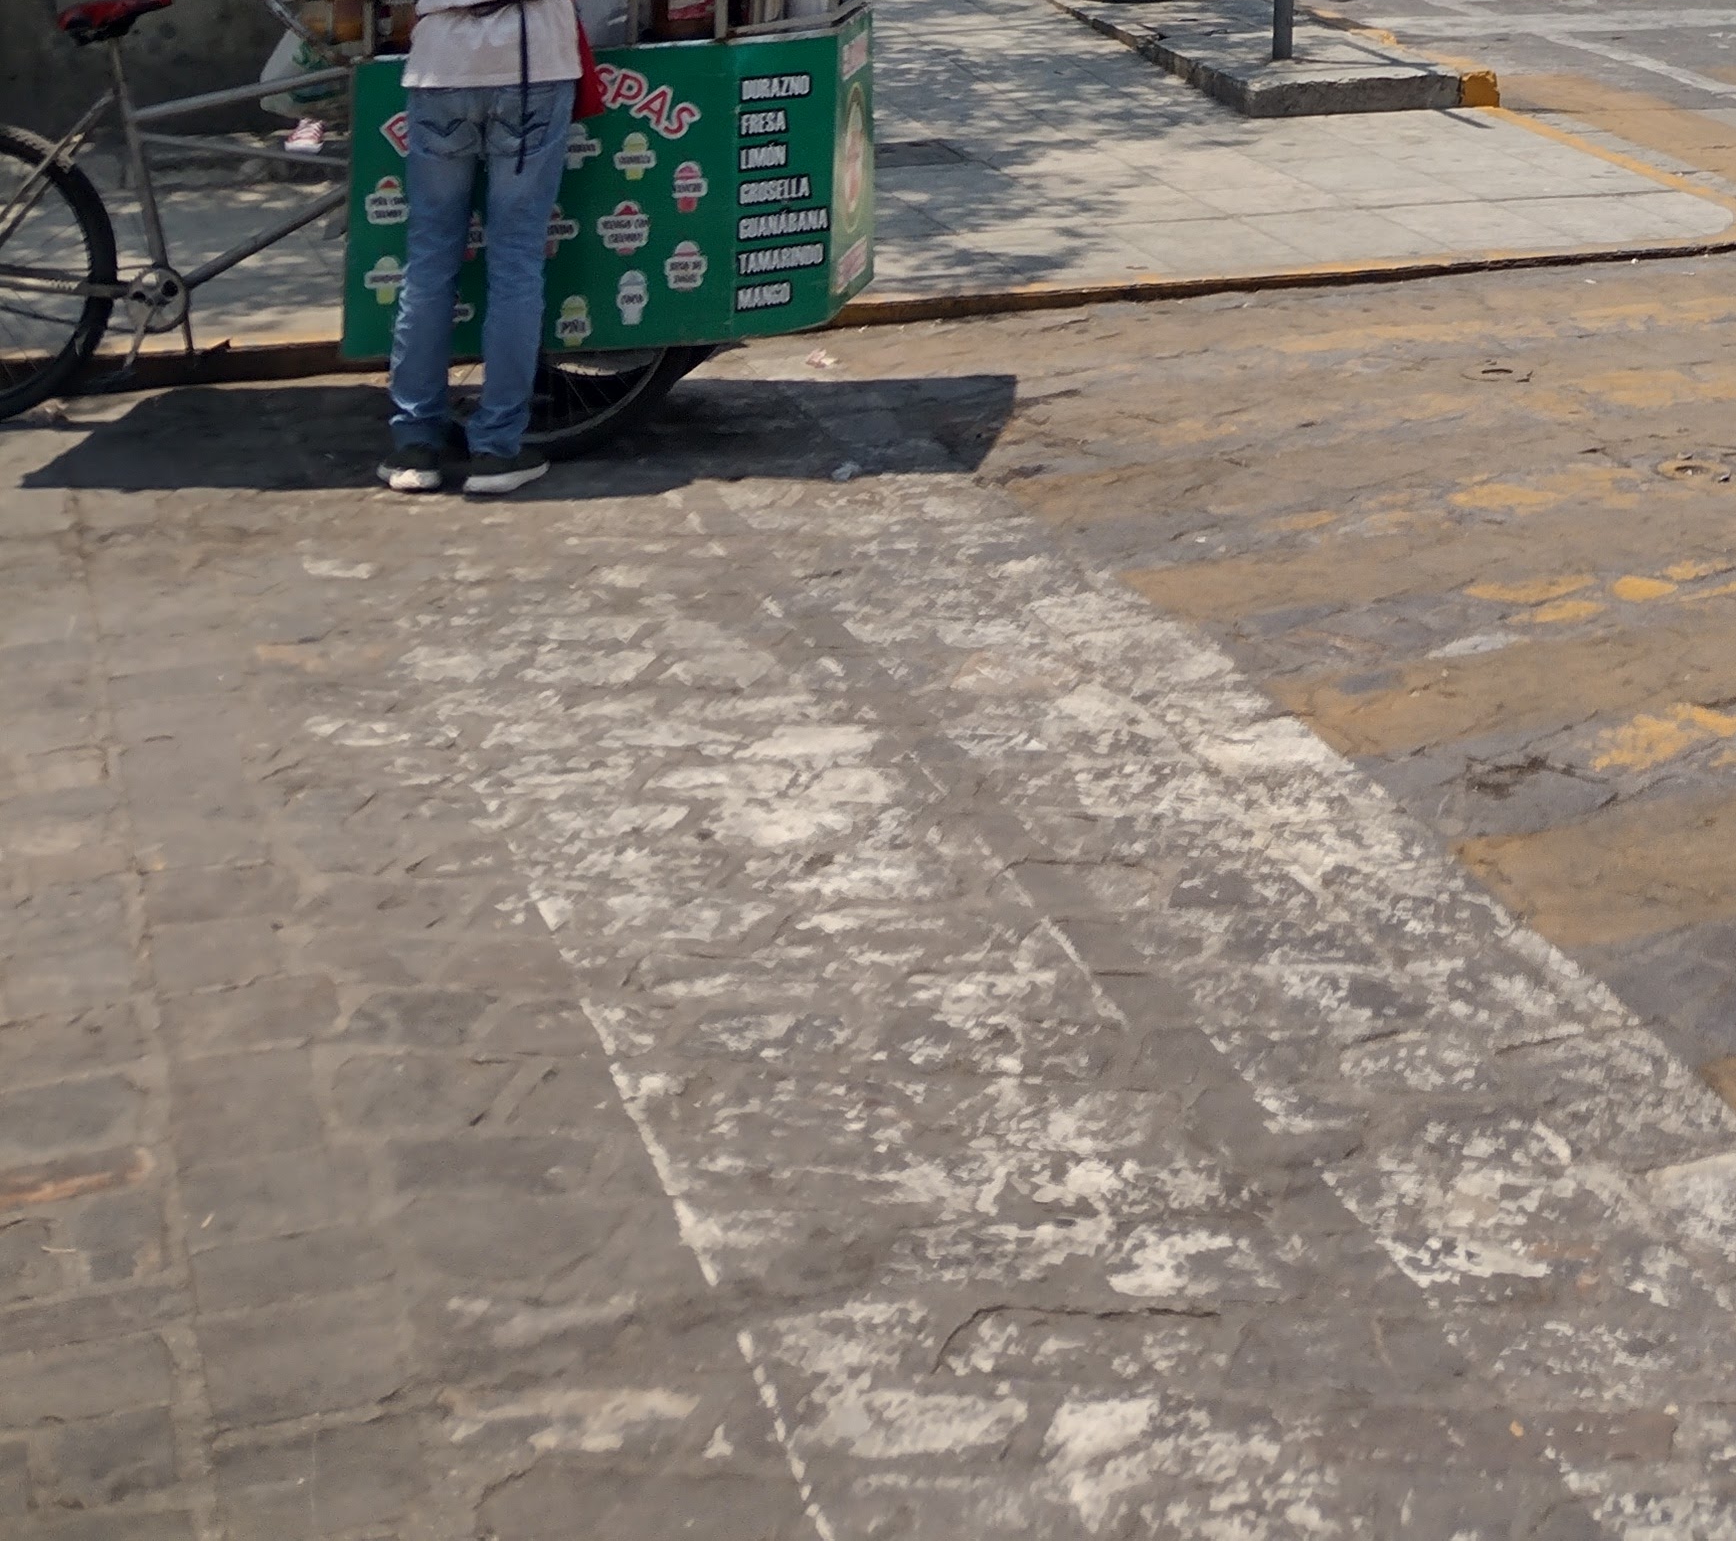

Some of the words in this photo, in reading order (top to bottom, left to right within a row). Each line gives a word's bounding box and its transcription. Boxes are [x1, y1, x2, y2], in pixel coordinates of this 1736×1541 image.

[596, 63, 701, 140] SPAS
[741, 74, 811, 101] DURAZNO
[740, 110, 787, 136] FRESA
[740, 142, 787, 170] LIMÓN
[739, 176, 811, 205] GROSELLA
[739, 207, 828, 240] GUANÁBANA
[738, 243, 824, 275] TAMARINDO
[737, 281, 790, 311] MANGO
